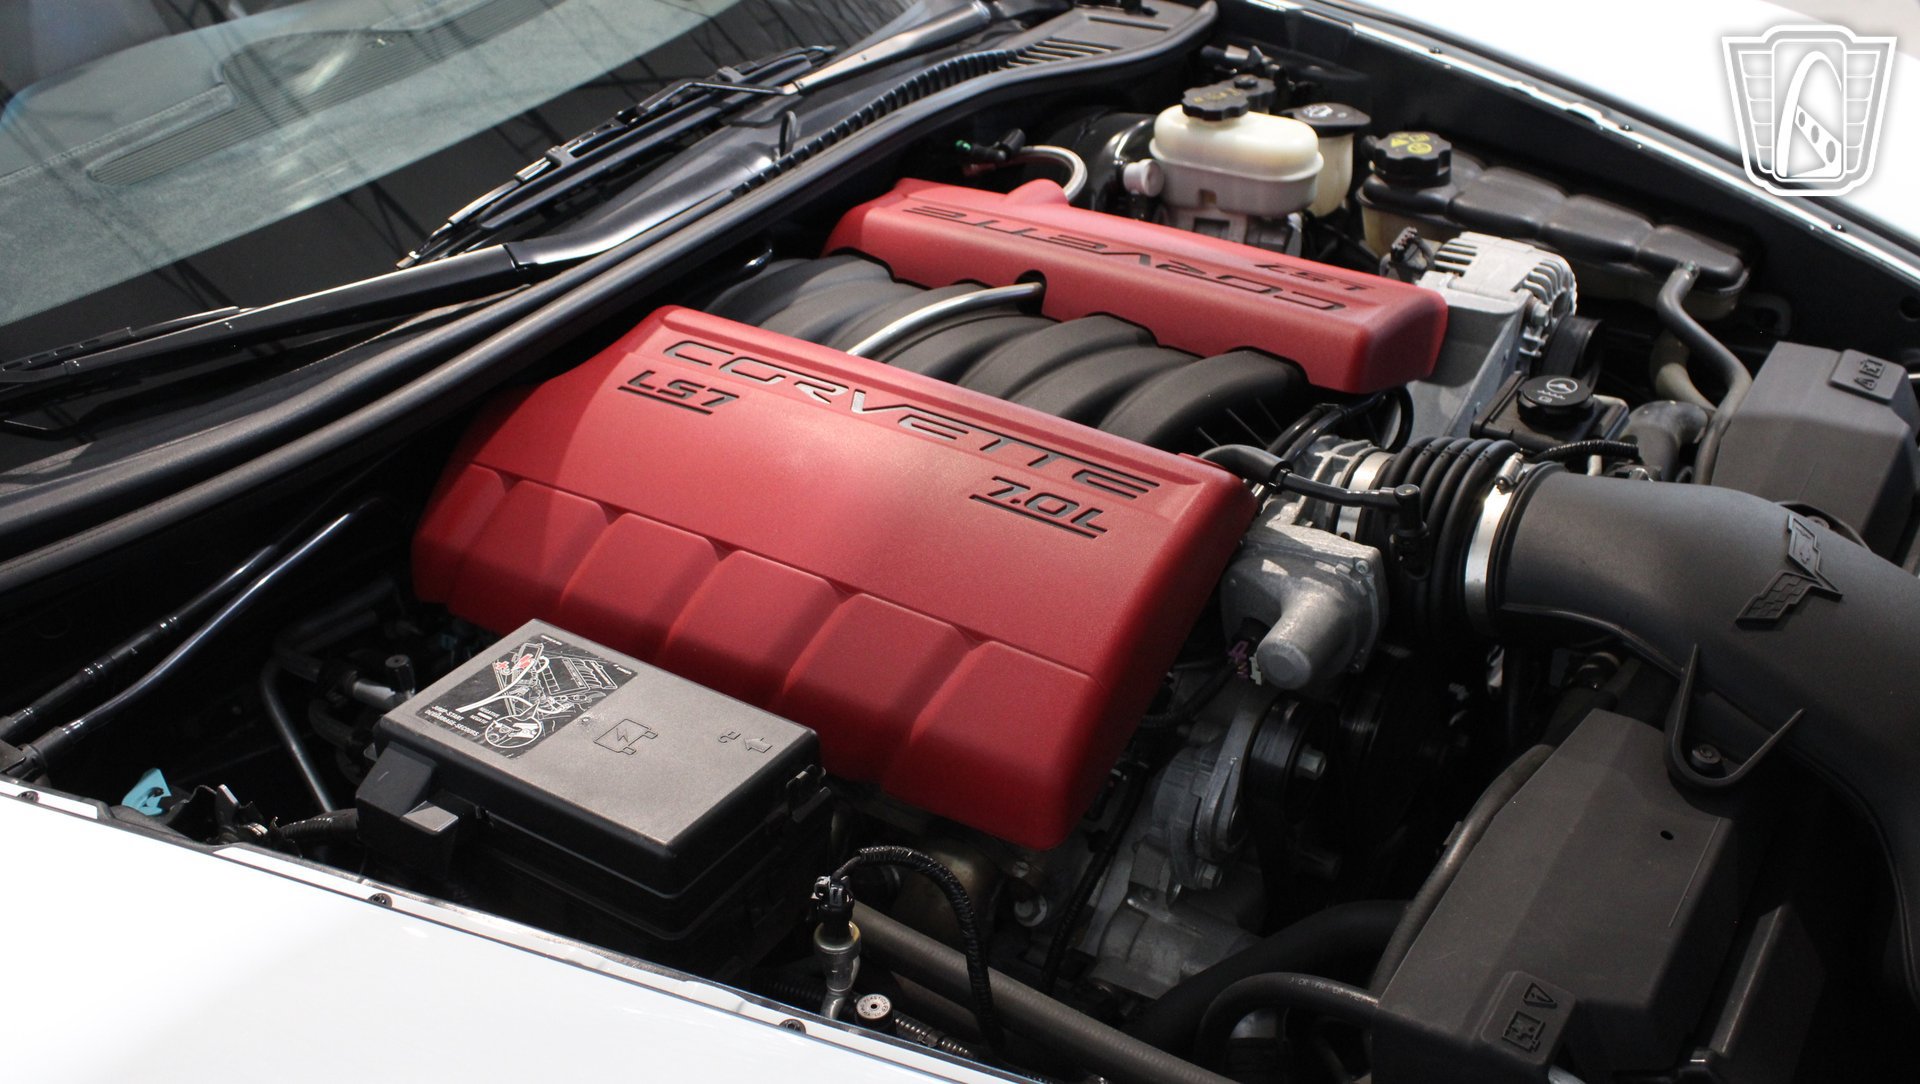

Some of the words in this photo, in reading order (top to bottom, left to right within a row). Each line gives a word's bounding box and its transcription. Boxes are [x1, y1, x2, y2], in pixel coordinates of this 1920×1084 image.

[903, 205, 1346, 311] CORVETTE
[628, 369, 741, 408] LS7
[663, 339, 1161, 500] CORVETTE
[988, 475, 1109, 534] 7.0L
